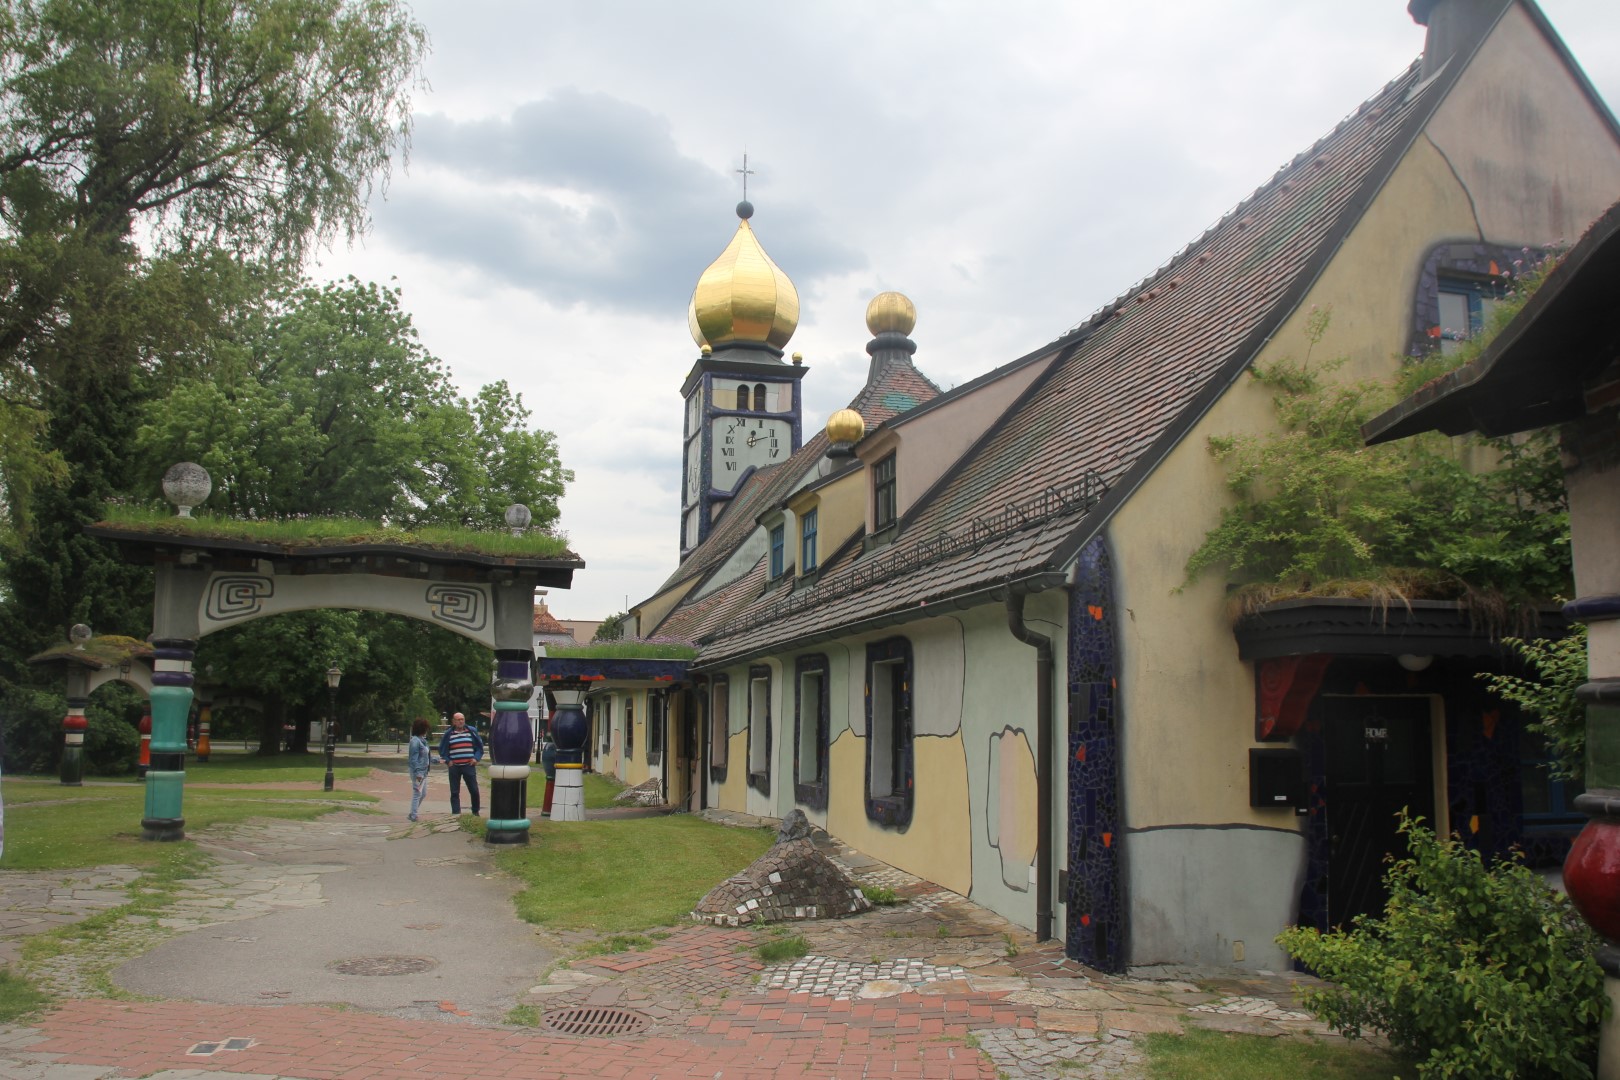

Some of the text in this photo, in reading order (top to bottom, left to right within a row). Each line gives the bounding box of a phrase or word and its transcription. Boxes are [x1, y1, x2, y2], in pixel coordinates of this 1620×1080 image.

[727, 425, 735, 434] X
[769, 449, 780, 458] IV
[726, 462, 737, 471] VII
[1365, 727, 1388, 738] HOME
